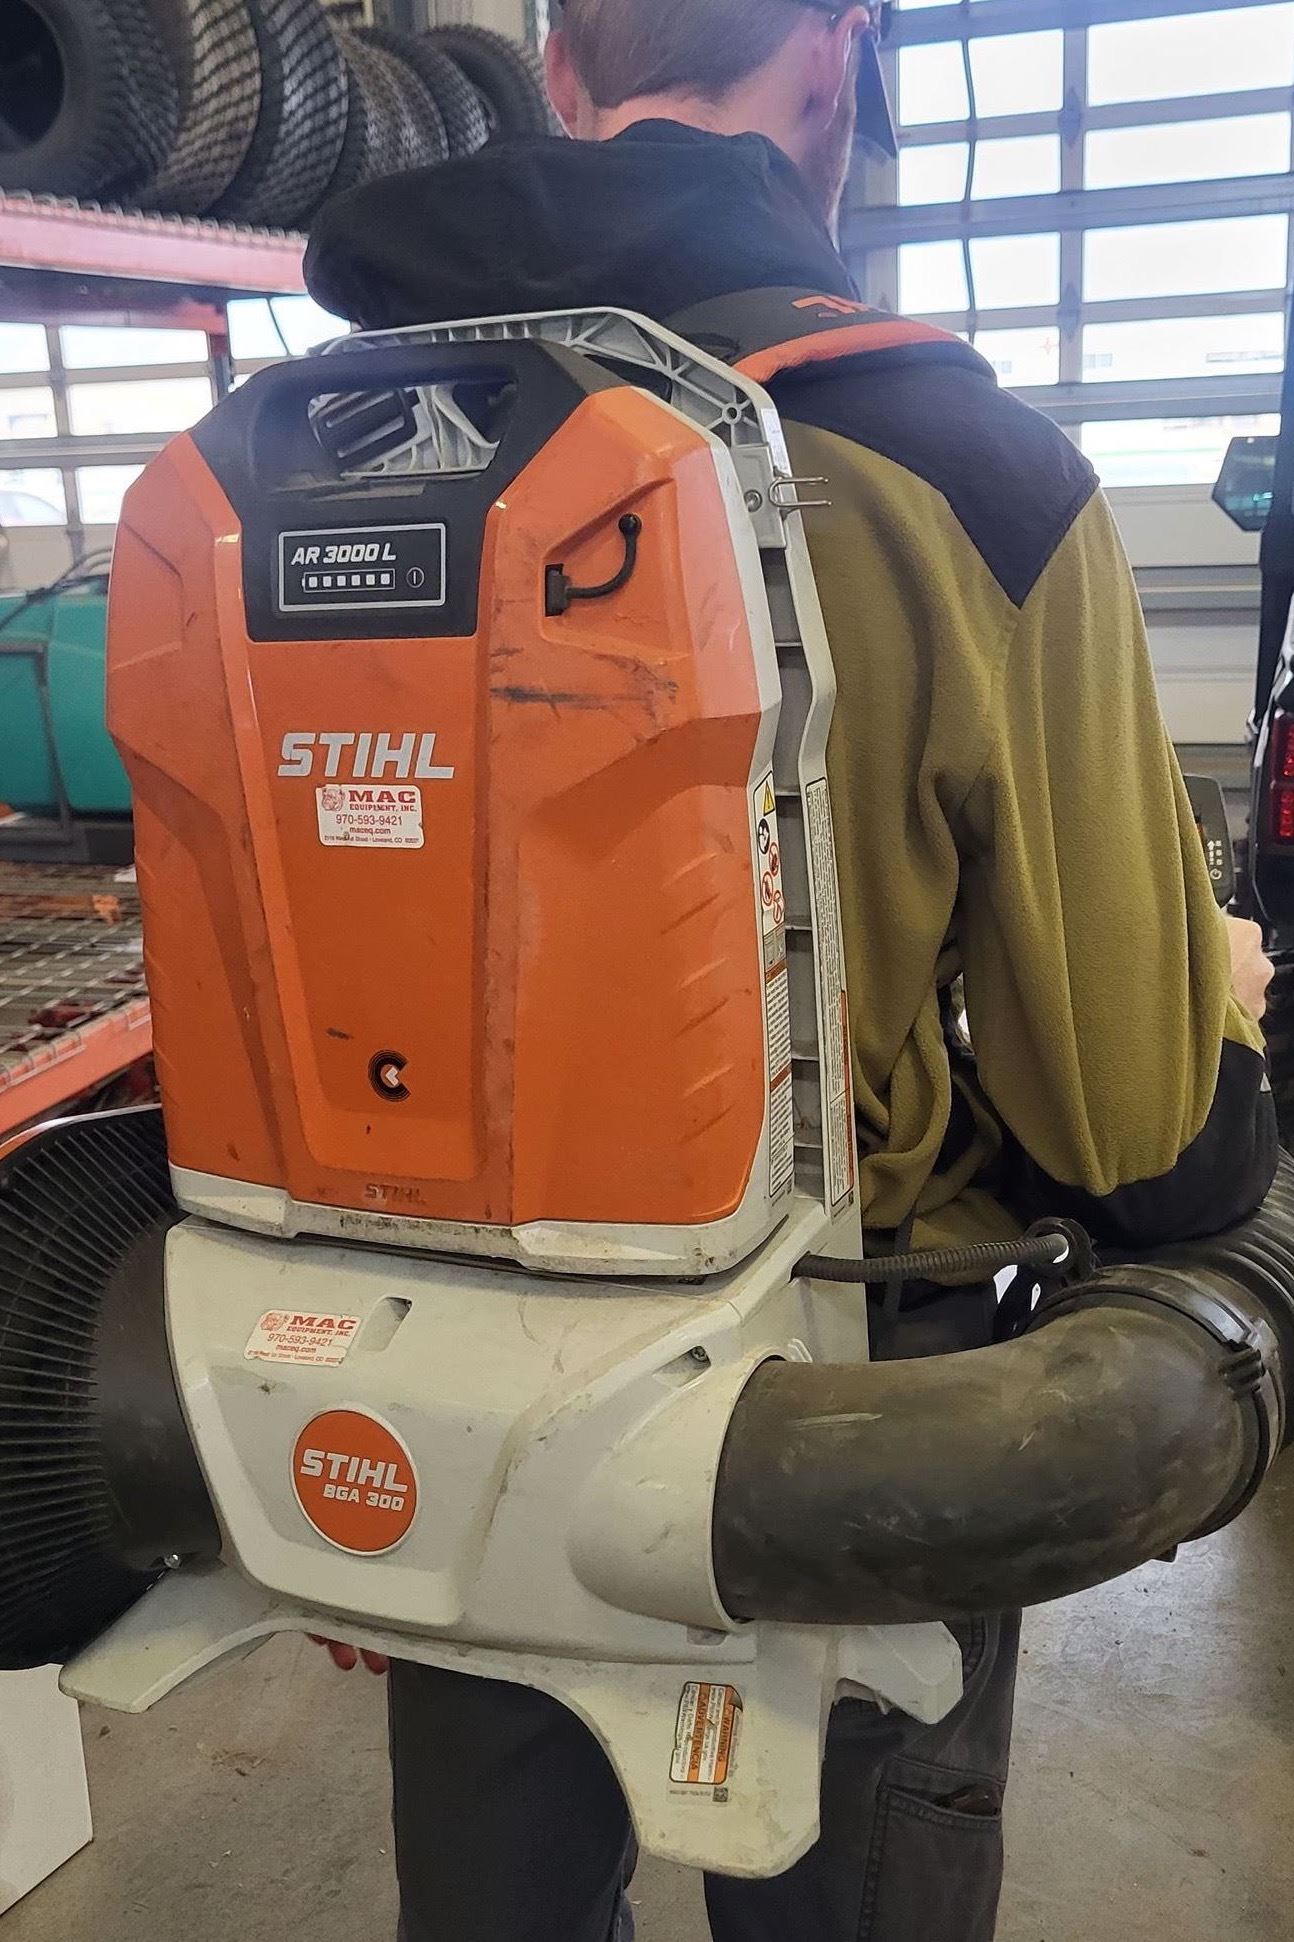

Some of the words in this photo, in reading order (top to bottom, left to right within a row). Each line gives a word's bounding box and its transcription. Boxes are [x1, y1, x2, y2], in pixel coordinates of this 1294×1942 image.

[291, 547, 320, 566] AR
[323, 543, 380, 563] 3000
[382, 543, 396, 561] L
[278, 733, 455, 778] STIHL
[349, 790, 416, 803] MAC
[336, 814, 402, 825] 970-593-9421
[350, 827, 391, 835] maceq.com
[290, 1316, 356, 1329] MAC
[267, 1333, 332, 1347] 970-593-9421
[300, 1449, 408, 1492] STIHL
[323, 1484, 359, 1503] BGA
[366, 1492, 404, 1511] 300
[691, 1701, 706, 1770] ADVERTENCIA
[719, 1716, 729, 1762] WARNING
